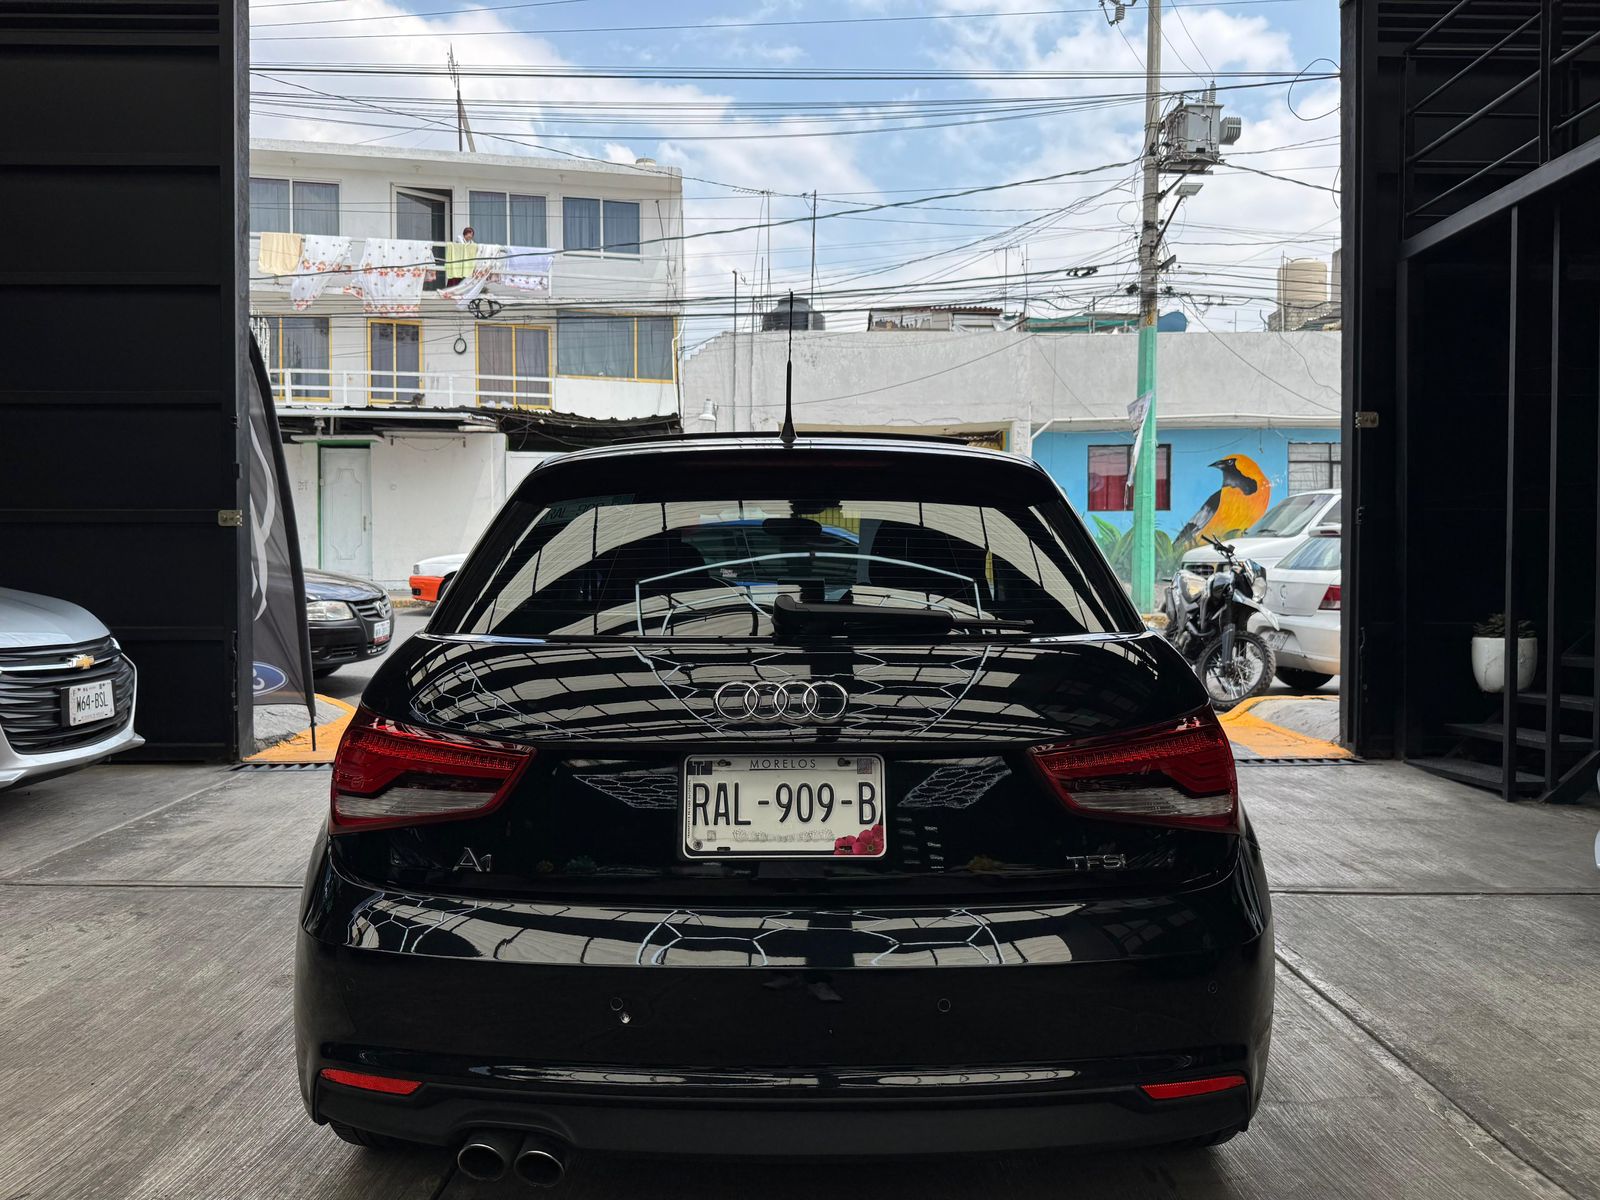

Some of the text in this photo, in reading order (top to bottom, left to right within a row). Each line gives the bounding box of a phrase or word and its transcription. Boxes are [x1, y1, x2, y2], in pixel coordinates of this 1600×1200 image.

[750, 759, 816, 769] MORELOS
[692, 782, 876, 826] RAL-909-B
[452, 846, 492, 872] A1
[1066, 853, 1127, 872] TFSI
